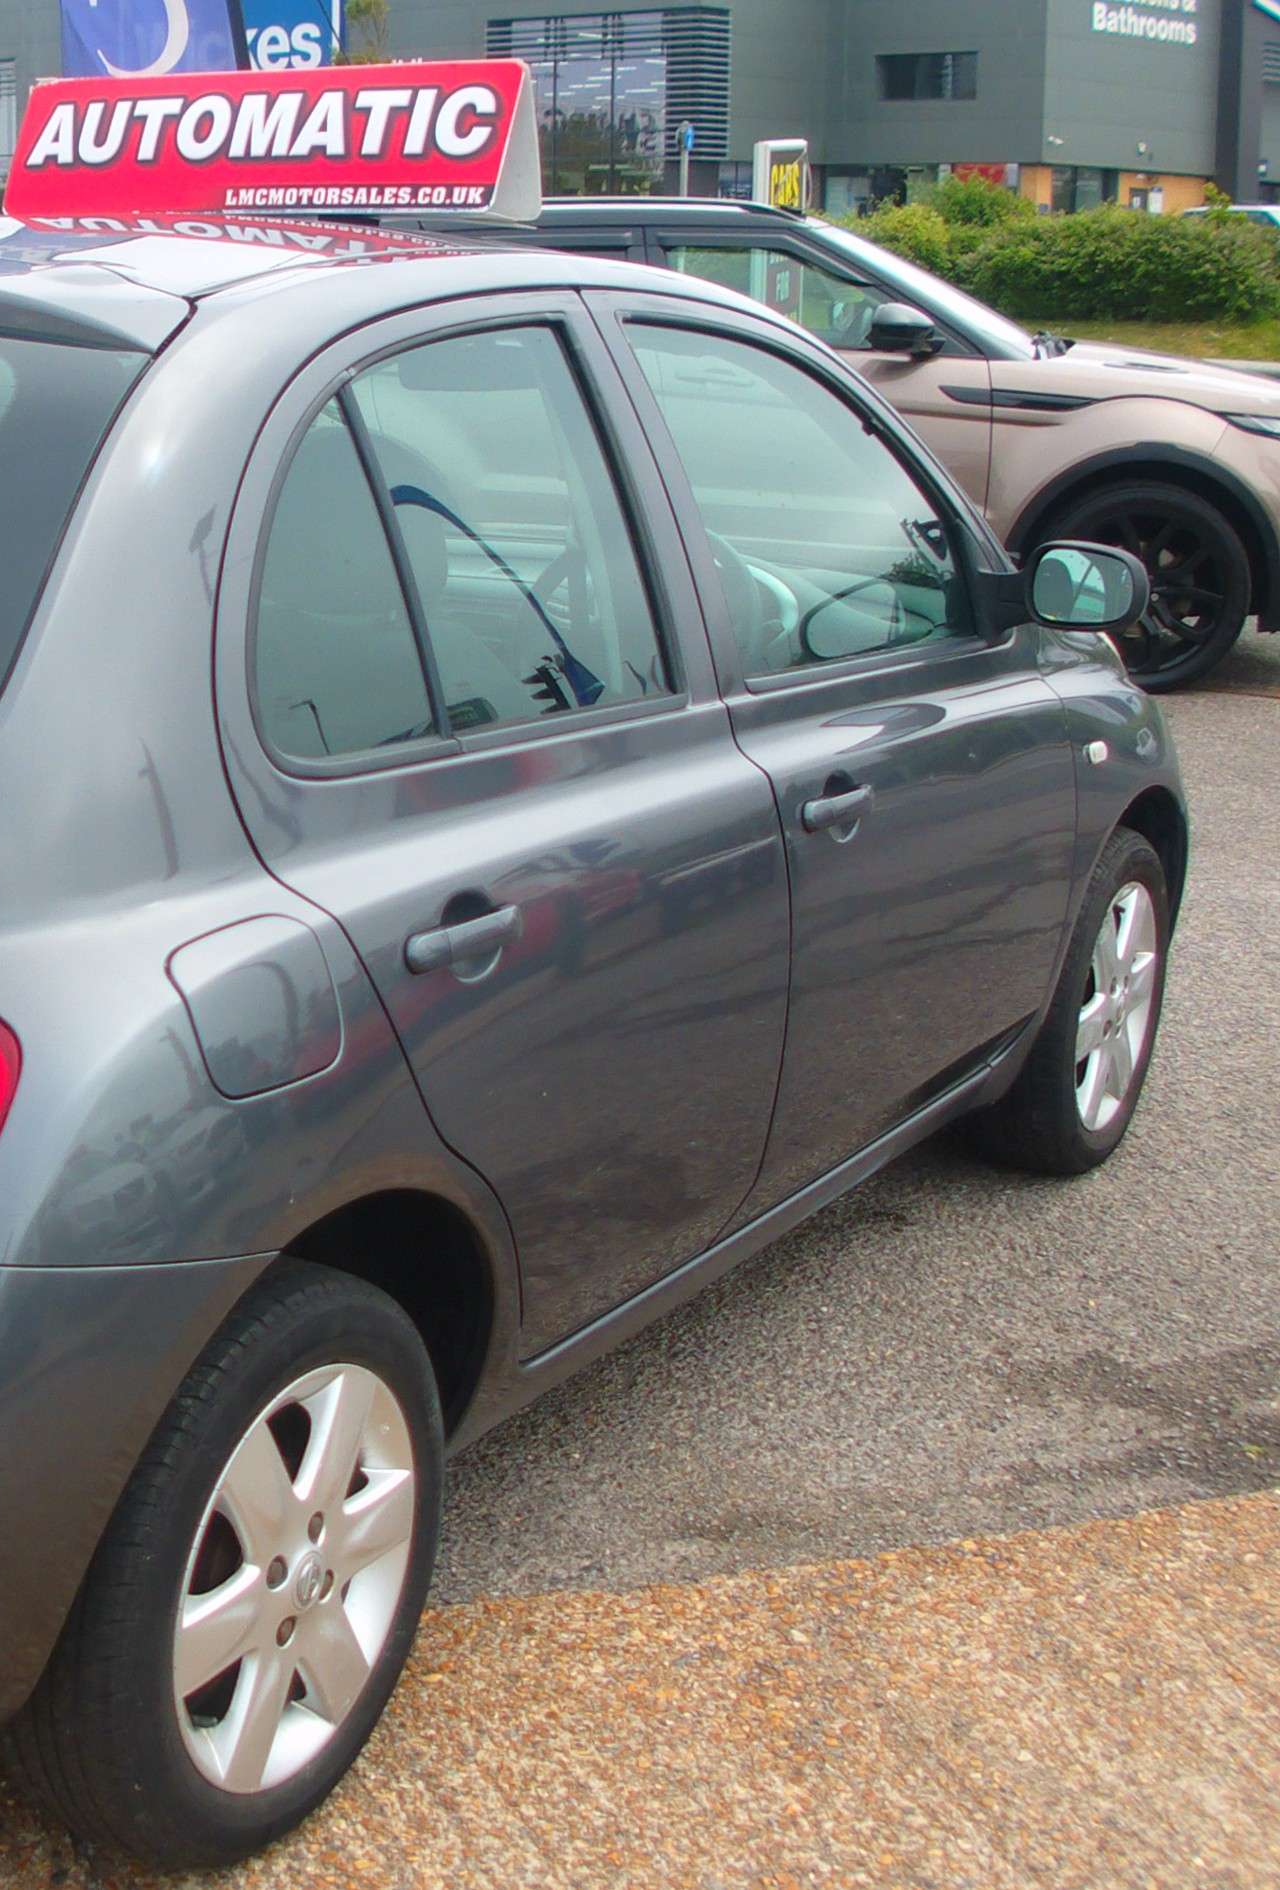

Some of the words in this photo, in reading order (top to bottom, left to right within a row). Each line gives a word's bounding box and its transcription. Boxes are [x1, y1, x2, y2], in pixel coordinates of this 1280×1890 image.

[1094, 2, 1196, 44] Bathrooms
[26, 86, 496, 166] AUTOMATIC
[225, 186, 485, 206] LMCMOTORSALES.CO.UK
